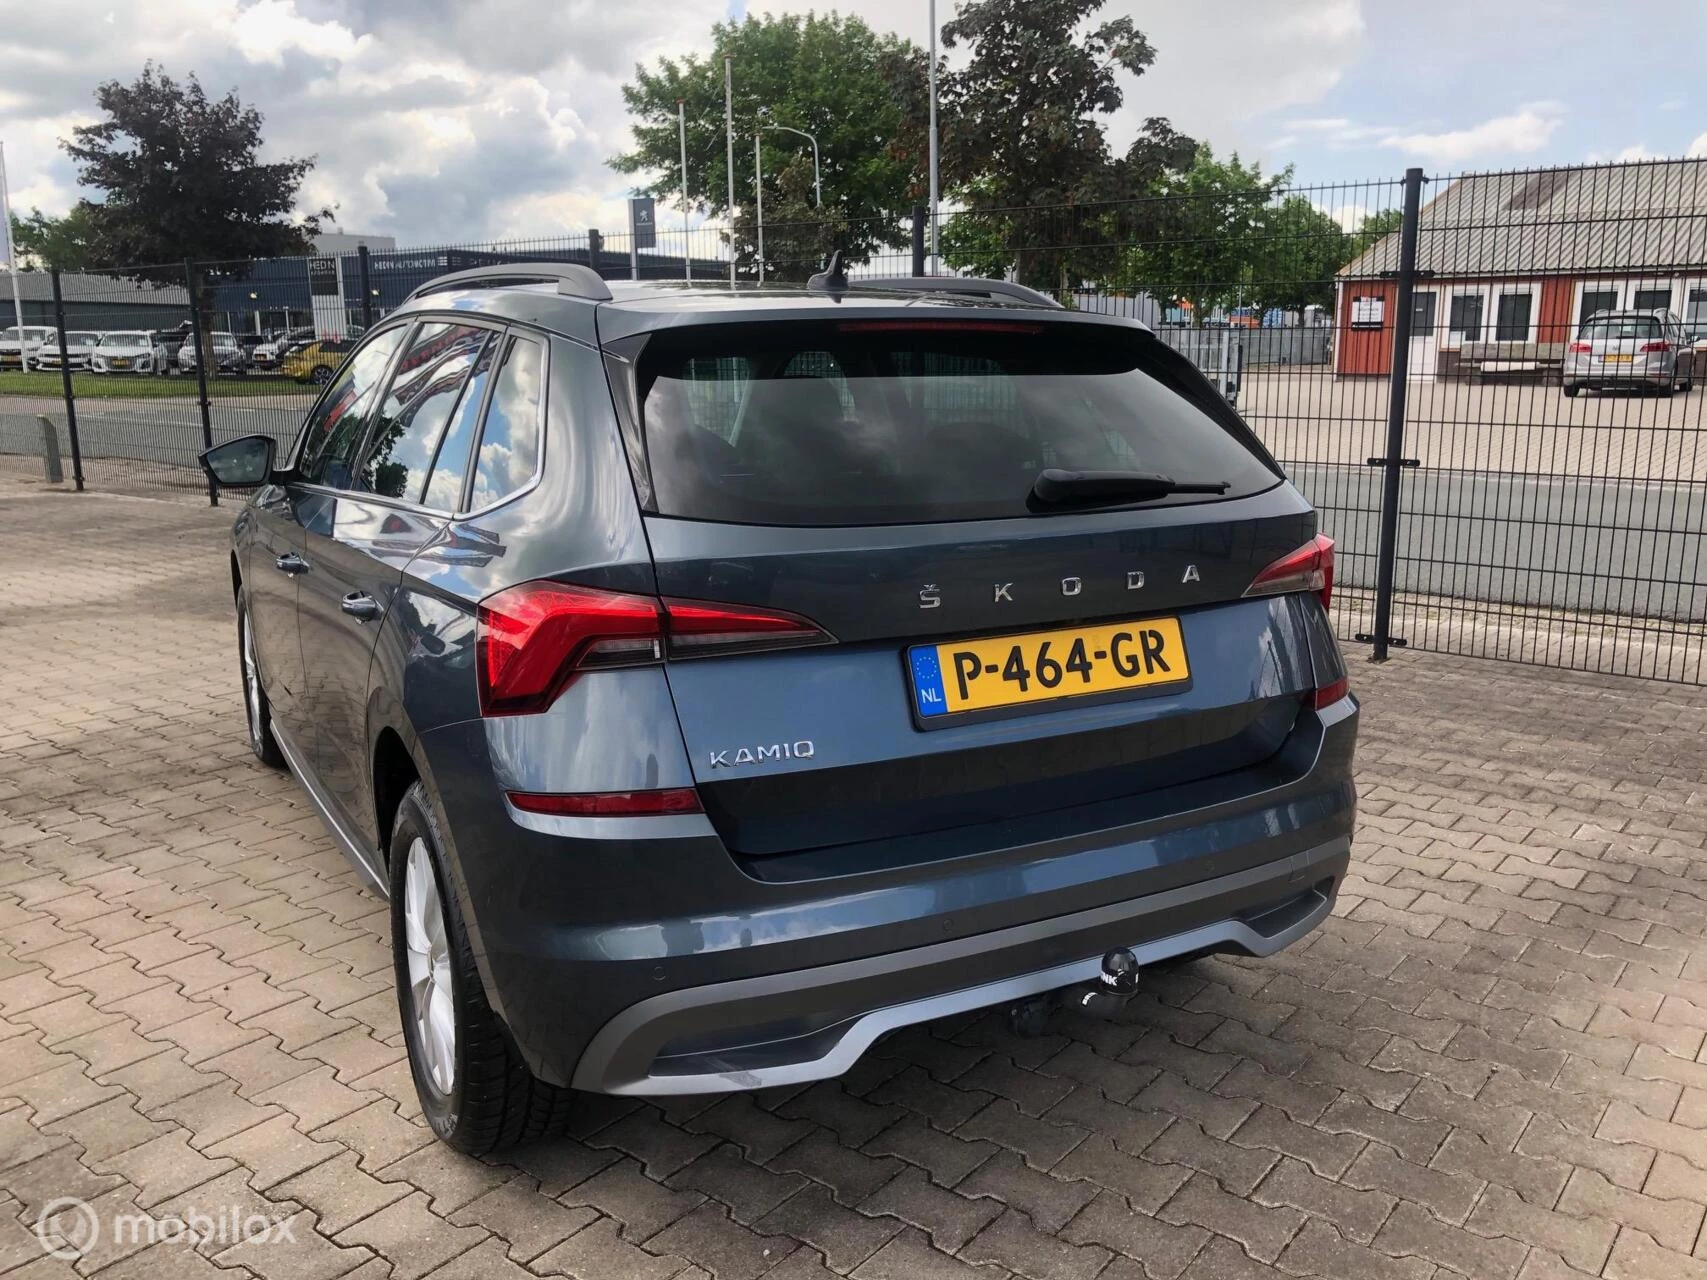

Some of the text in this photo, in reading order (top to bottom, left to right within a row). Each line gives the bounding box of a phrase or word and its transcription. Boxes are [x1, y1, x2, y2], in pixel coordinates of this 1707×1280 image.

[919, 564, 1200, 609] ŠKODA
[953, 629, 1172, 700] P-464-GR
[921, 688, 942, 704] NL
[709, 740, 815, 769] KAMIQ
